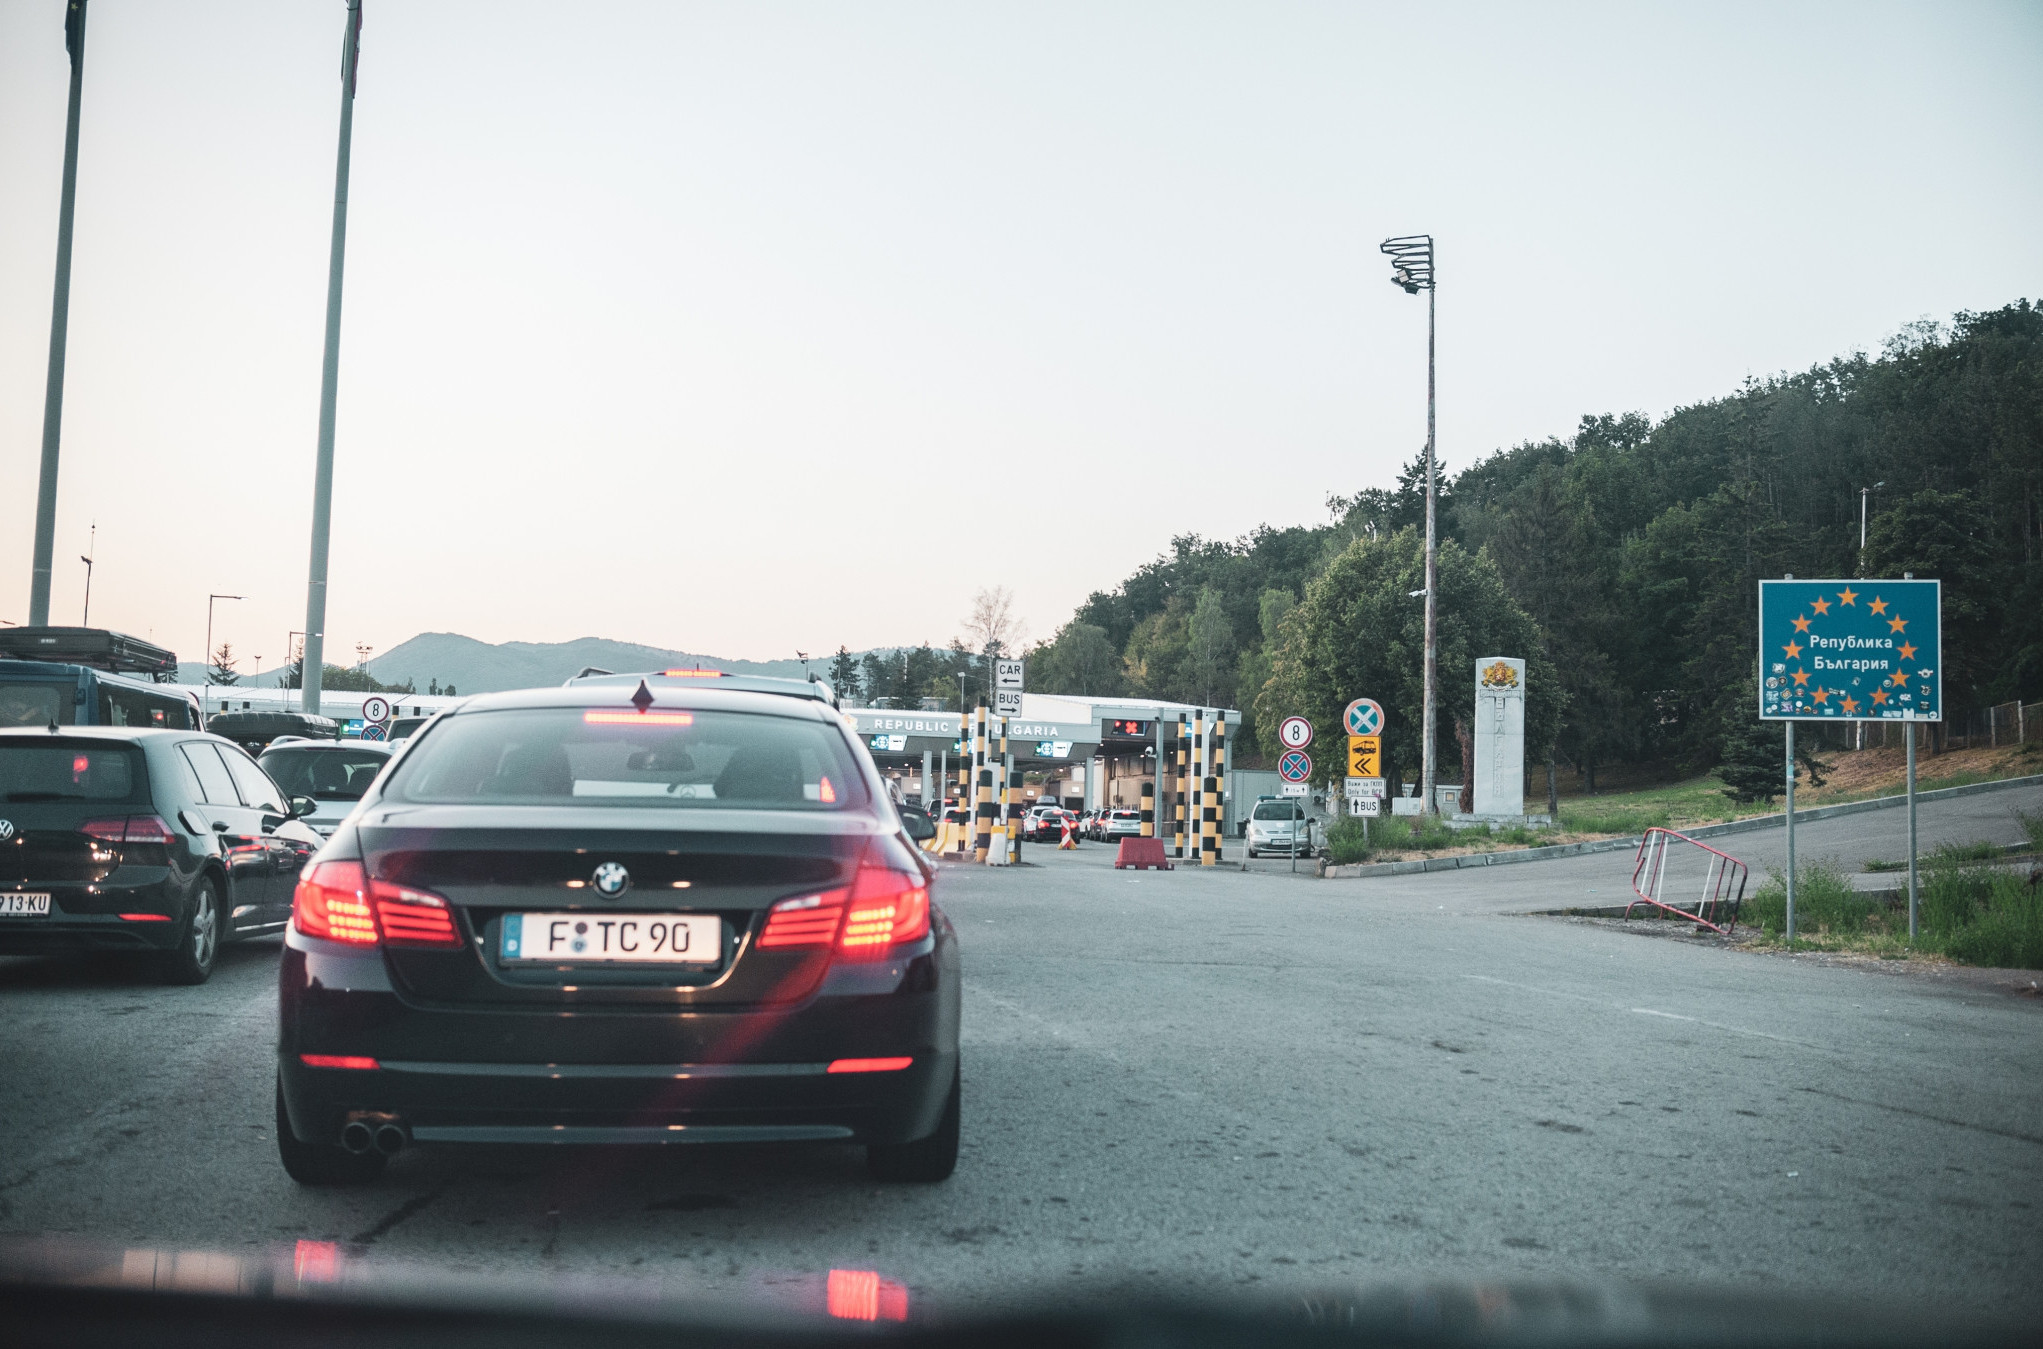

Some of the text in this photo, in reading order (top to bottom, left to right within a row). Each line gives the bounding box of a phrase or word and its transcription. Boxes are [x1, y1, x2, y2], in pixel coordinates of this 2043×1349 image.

[1810, 635, 1893, 651] Република
[1000, 665, 1020, 674] CAR
[1814, 656, 1889, 672] България
[999, 694, 1019, 704] BUS
[372, 703, 379, 716] 8
[874, 719, 949, 732] REPUBLIC
[1292, 725, 1300, 740] 8
[1361, 801, 1377, 811] BUS
[549, 921, 569, 952] F
[597, 922, 638, 952] TC
[650, 922, 690, 953] 90
